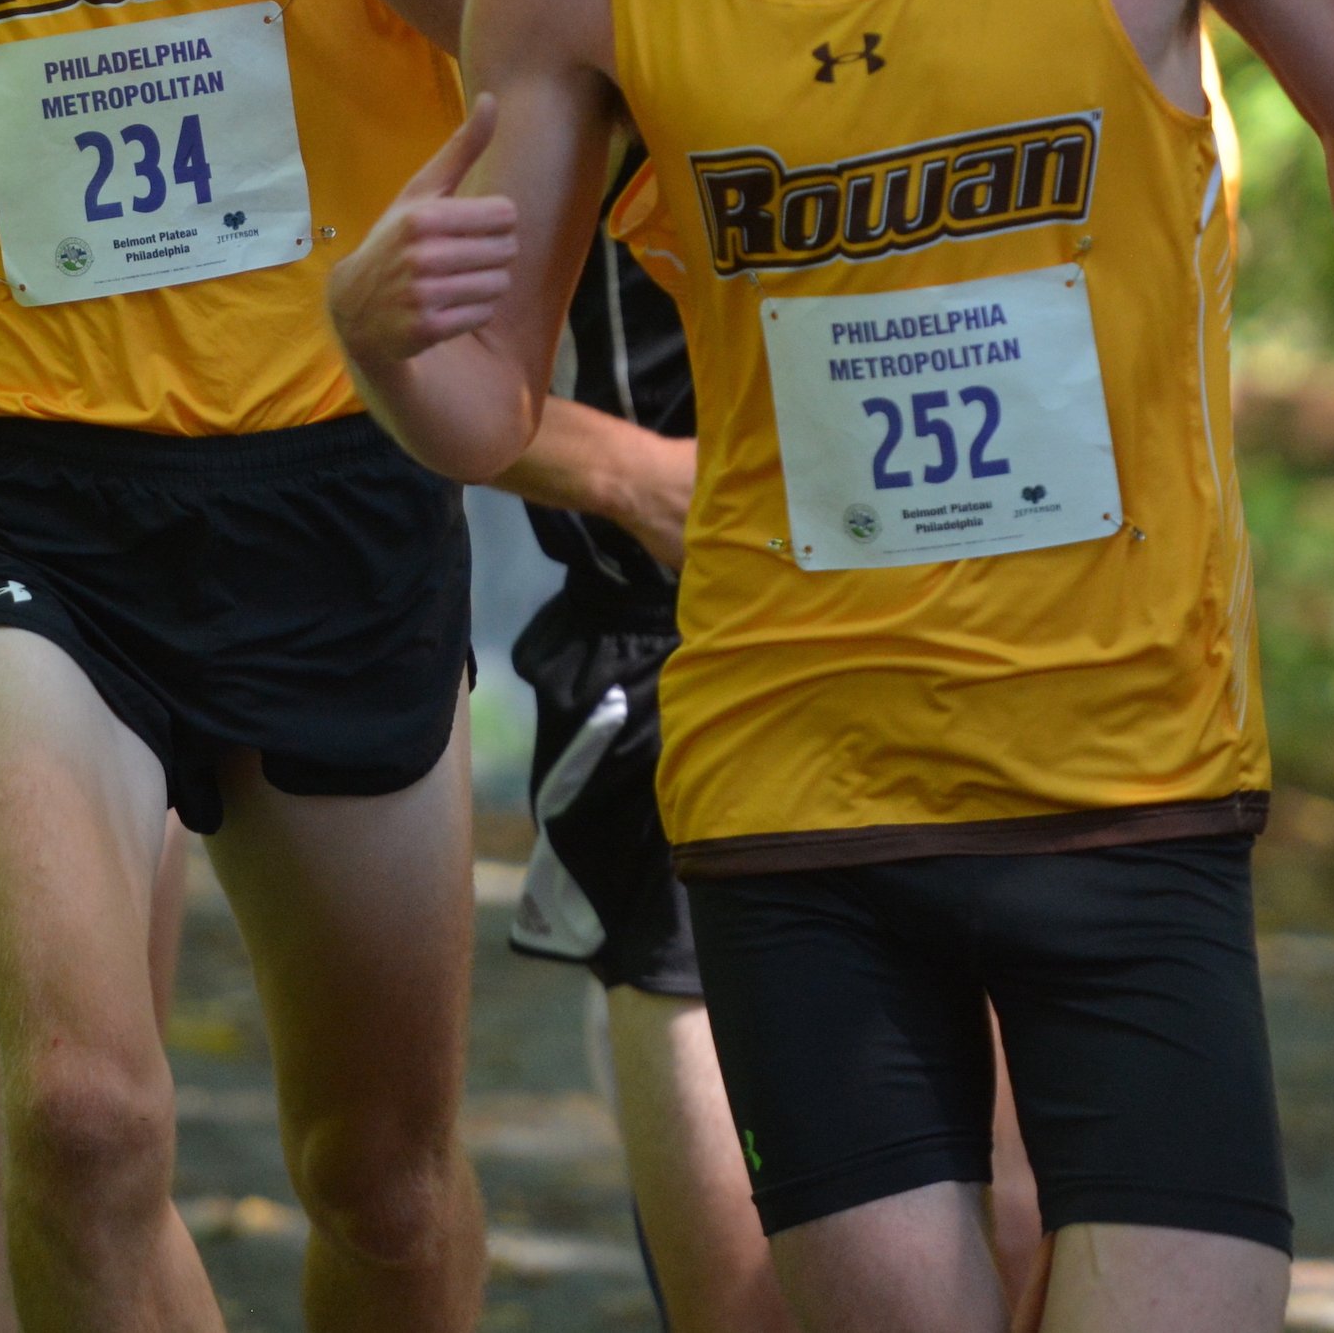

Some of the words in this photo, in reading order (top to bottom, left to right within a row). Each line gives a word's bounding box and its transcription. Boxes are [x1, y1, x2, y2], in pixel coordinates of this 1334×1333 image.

[44, 38, 213, 84] PHILADELPHIA
[42, 70, 225, 119] METROPOLITAN
[74, 114, 213, 222] 234
[695, 121, 1094, 272] Rowan
[113, 233, 157, 250] Belmont
[159, 226, 198, 242] Plateau
[125, 243, 191, 263] Philadelphia
[216, 228, 260, 245] JEFFERSON
[831, 303, 1008, 346] PHILADELPHIA
[829, 337, 1022, 382] METROPOLITAN
[861, 385, 1012, 490] 252
[902, 504, 947, 519] Belmont
[915, 517, 984, 534] Philadelphia
